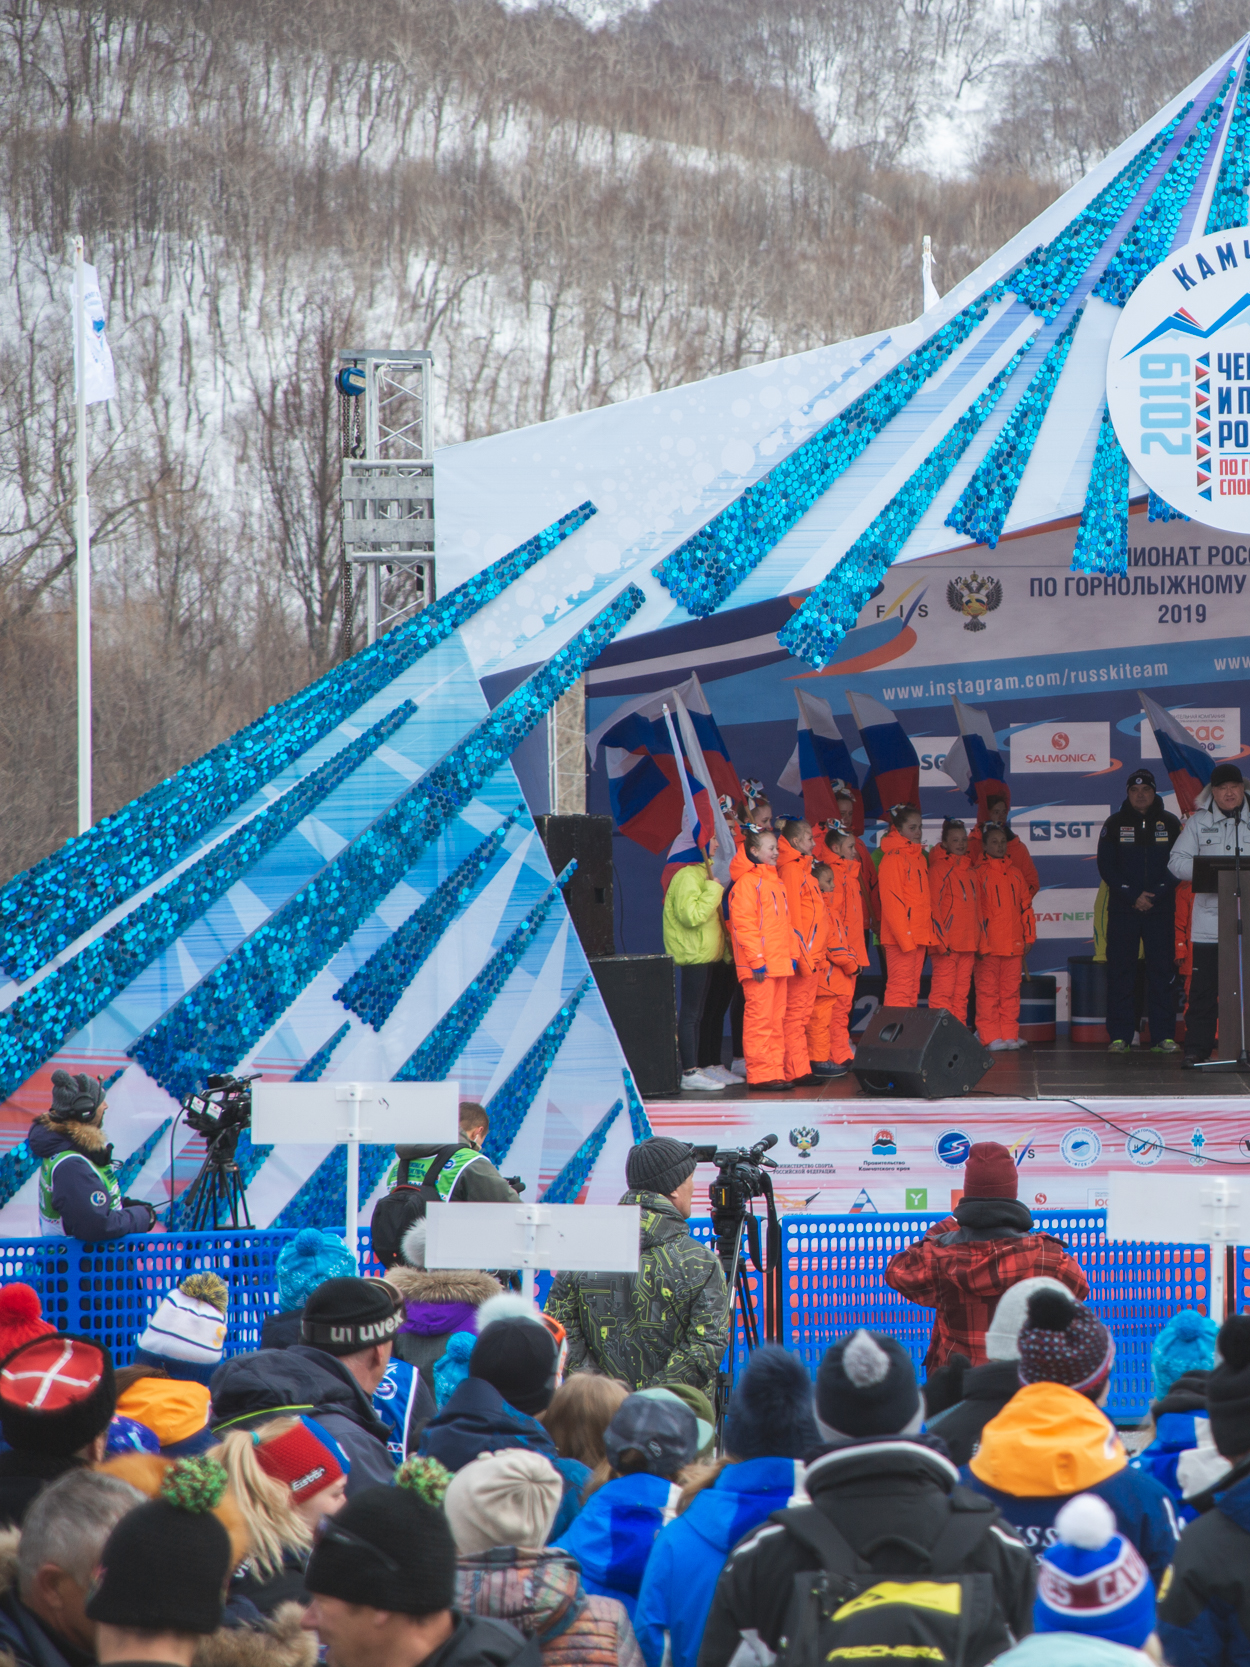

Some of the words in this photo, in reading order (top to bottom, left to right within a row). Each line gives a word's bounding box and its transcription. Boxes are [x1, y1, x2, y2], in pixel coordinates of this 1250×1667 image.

[1140, 353, 1191, 455] 2019
[1218, 386, 1232, 414] И
[1219, 458, 1238, 475] ПО
[1128, 545, 1201, 567] ИОНАТ
[1030, 577, 1057, 597] ПО
[1064, 574, 1247, 597] ГОРНОЛЫЖНОМУ
[1158, 604, 1207, 623] 2019
[882, 662, 1168, 700] www.instagram.com/russkiteam
[1025, 754, 1096, 763] SALMONICA
[1054, 821, 1095, 839] SGT
[1035, 912, 1095, 922] TATNEF
[359, 1308, 404, 1342] uvex
